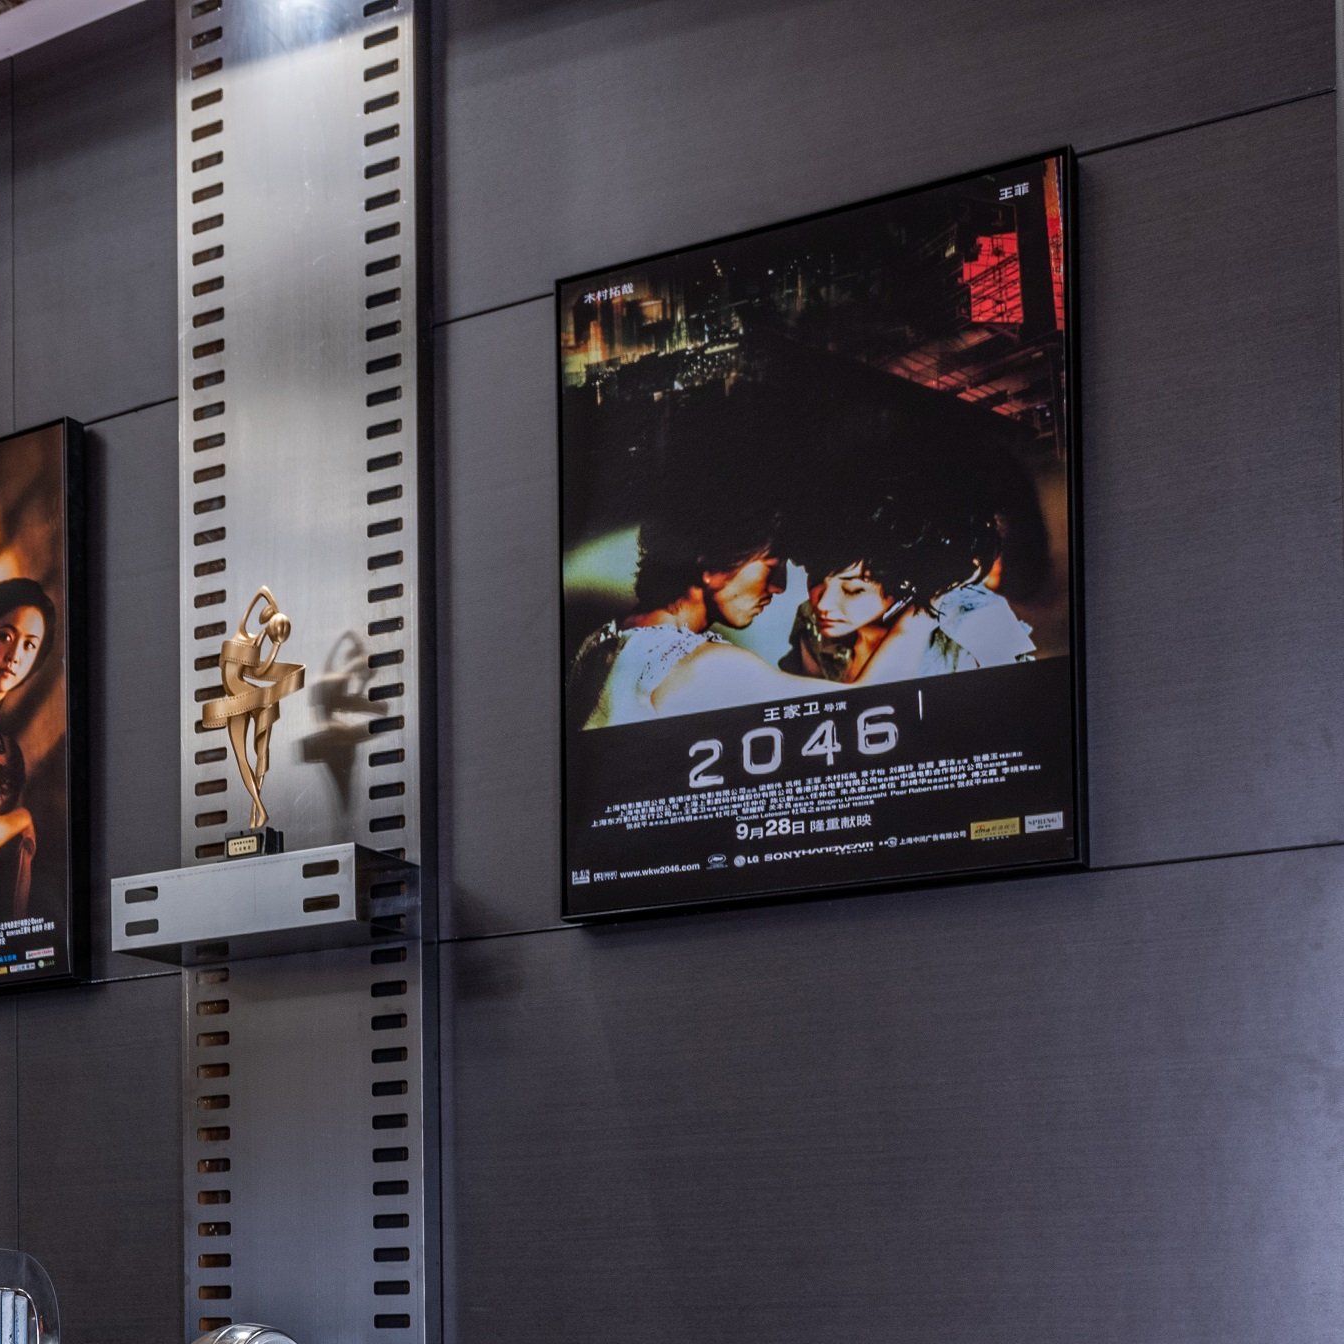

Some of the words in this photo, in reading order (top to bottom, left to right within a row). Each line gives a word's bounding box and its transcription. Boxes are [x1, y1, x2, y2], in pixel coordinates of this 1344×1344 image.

[998, 182, 1030, 201] 王菲
[583, 282, 634, 304] 木村拓哉
[688, 705, 899, 789] 2046
[735, 818, 805, 840] 9月28日
[810, 813, 873, 834] 隆重献映
[747, 855, 760, 864] LG
[619, 862, 701, 880] www.wkw2046.com
